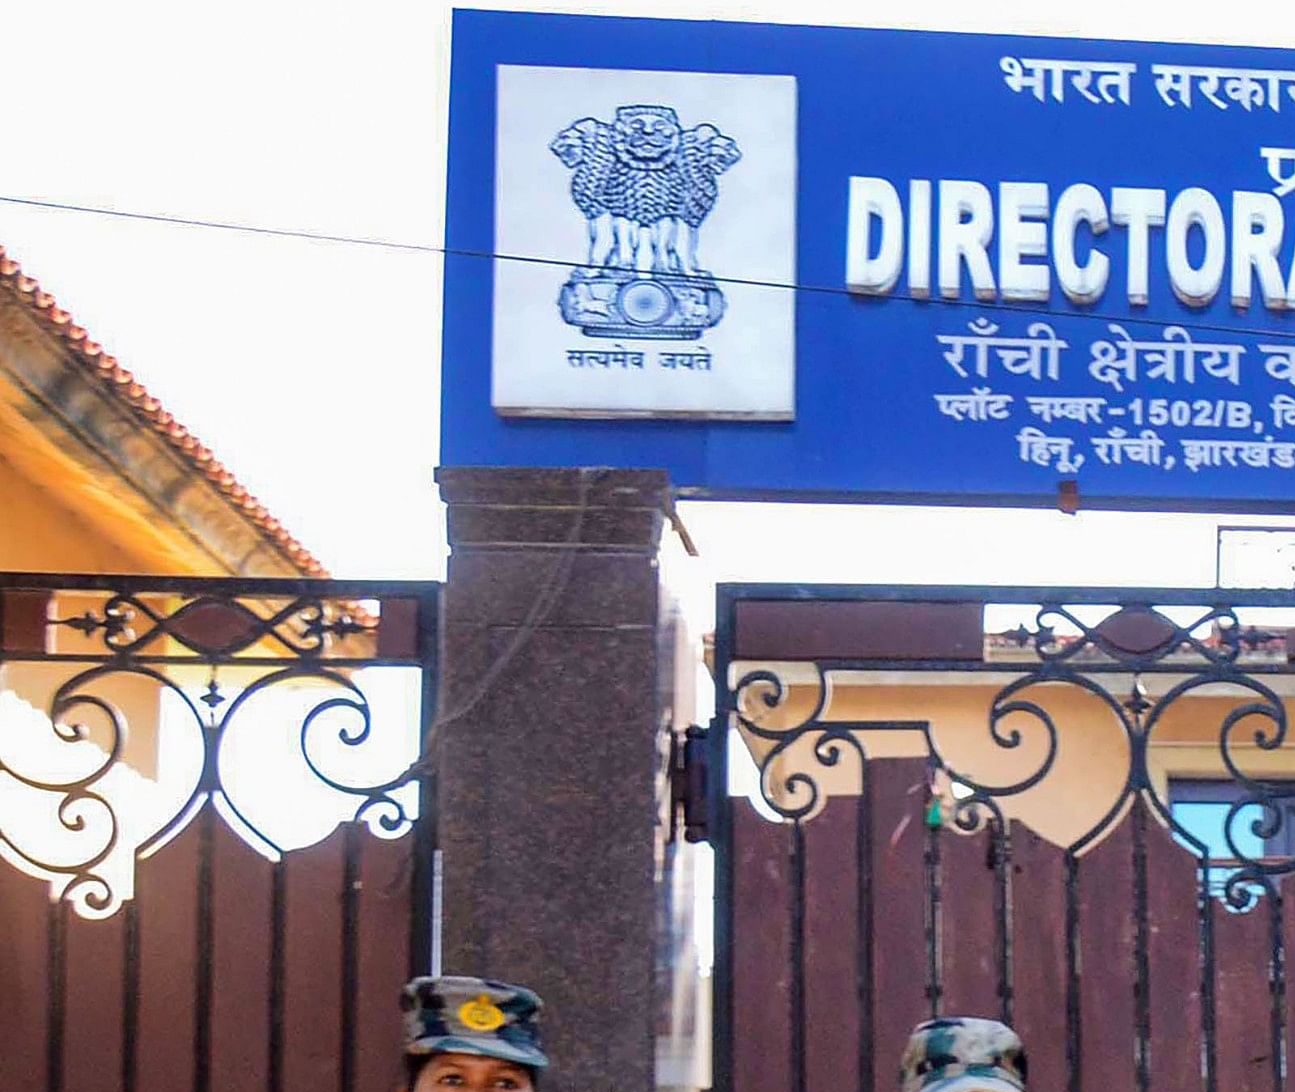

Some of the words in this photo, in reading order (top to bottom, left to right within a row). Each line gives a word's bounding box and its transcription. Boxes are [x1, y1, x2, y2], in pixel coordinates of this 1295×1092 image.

[1000, 56, 1137, 106] भारत
[565, 343, 645, 369] सत्यमेव
[658, 346, 712, 371] जयते
[937, 318, 1068, 380] राँची
[1089, 324, 1246, 392] क्षेत्रीय
[934, 387, 1014, 421] प्लॉट
[1016, 427, 1085, 473] हिनू,
